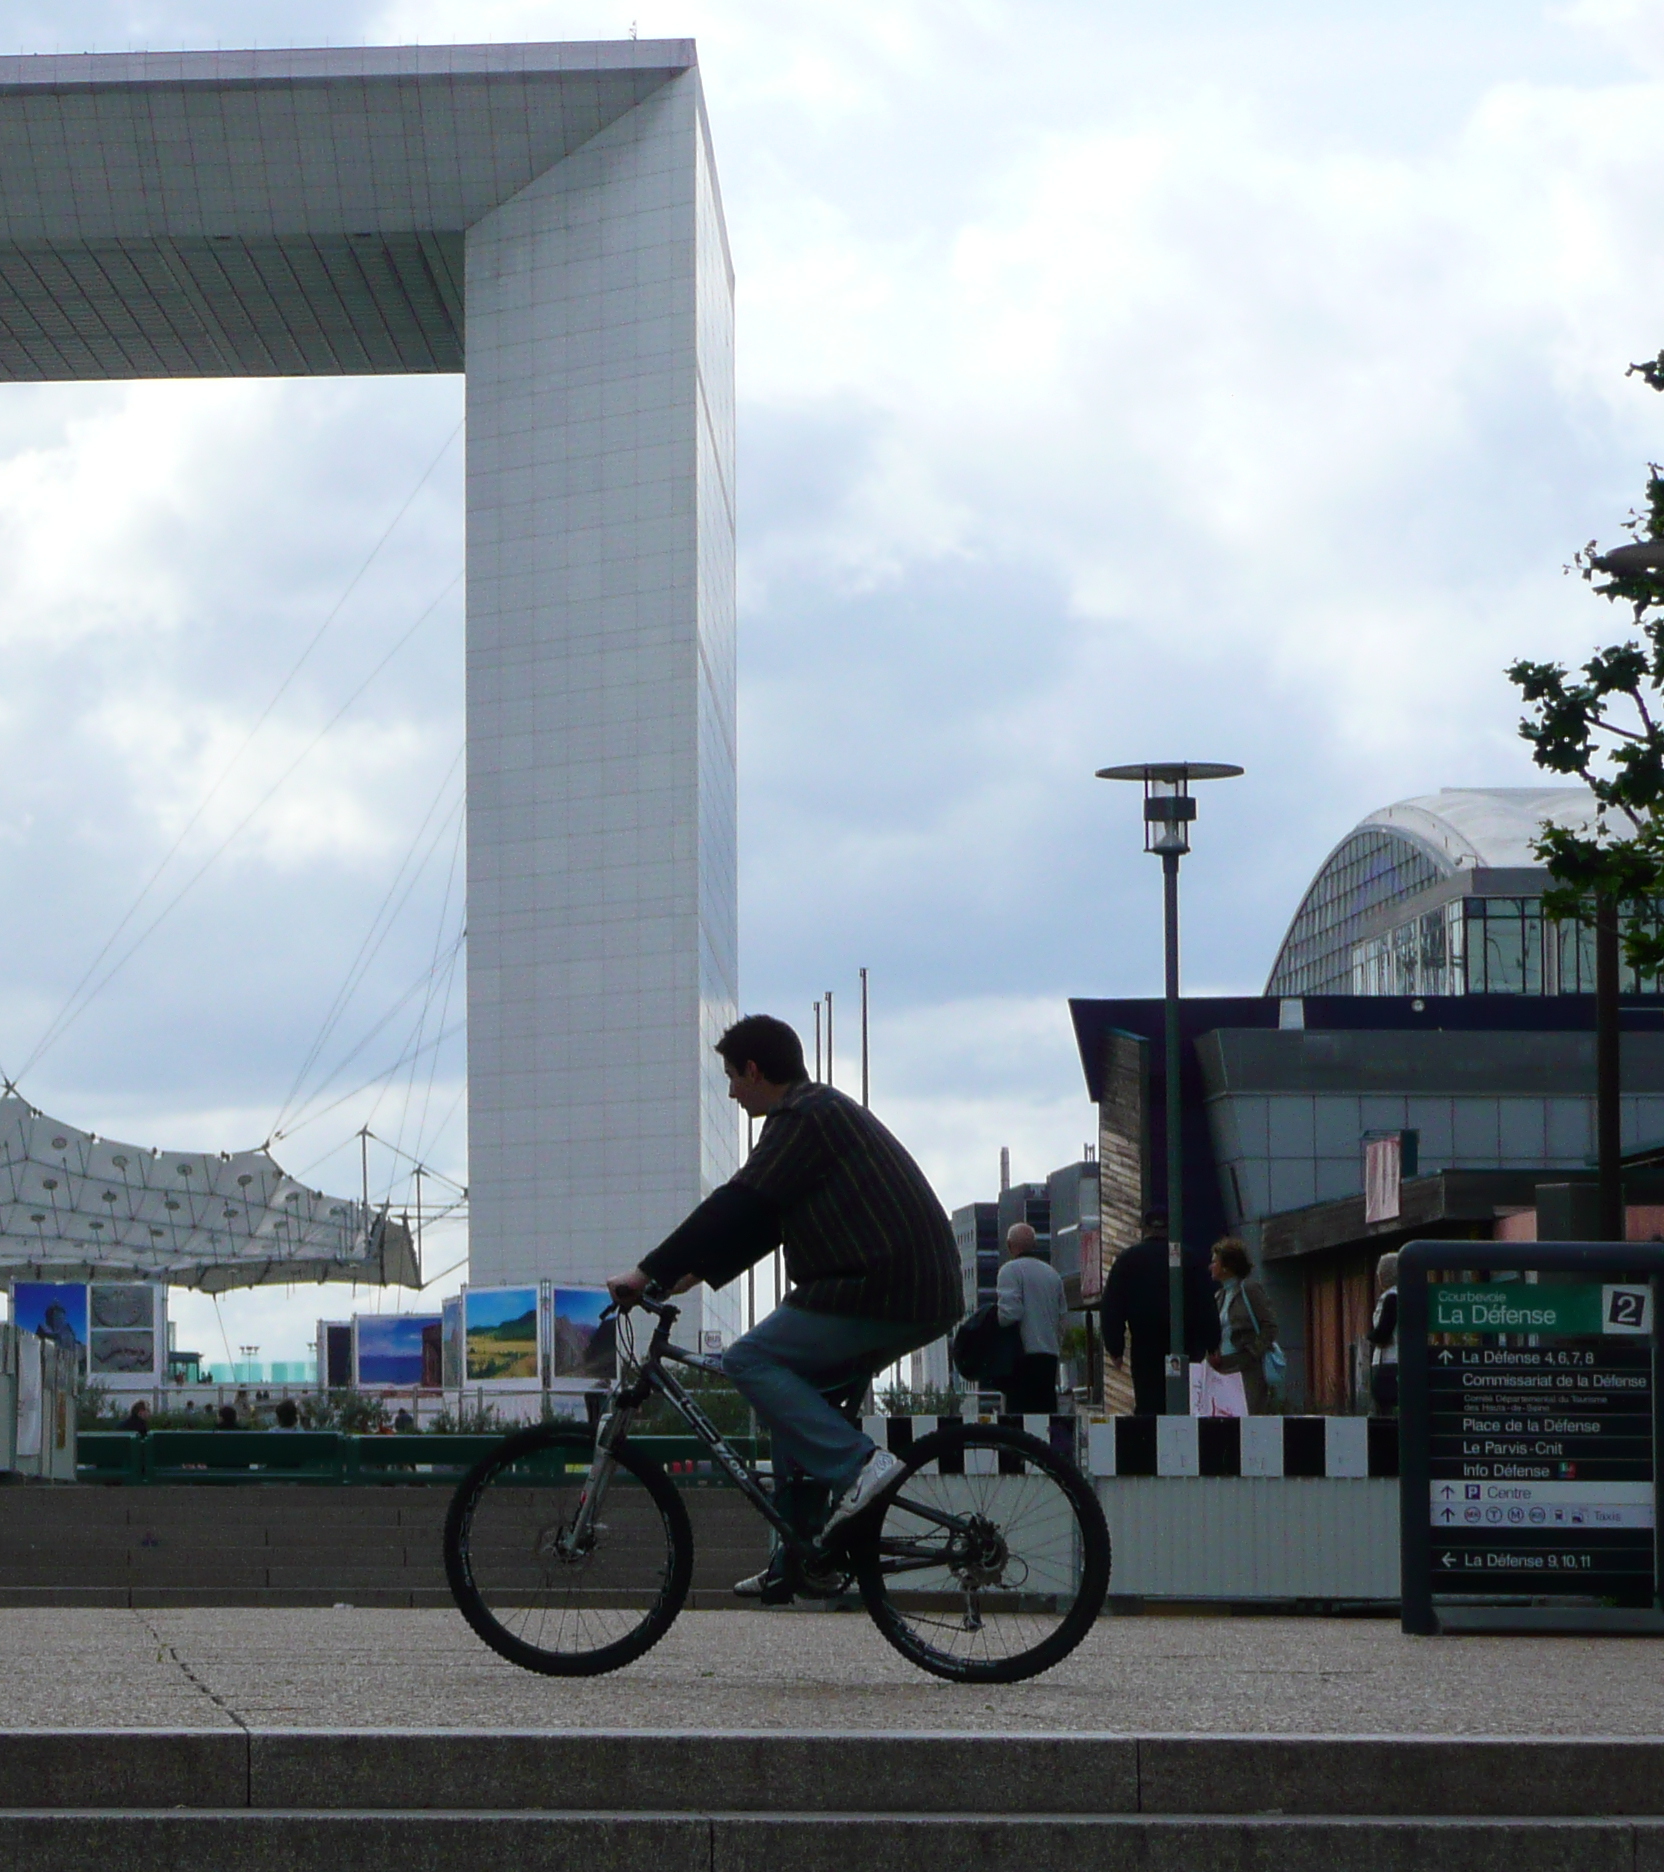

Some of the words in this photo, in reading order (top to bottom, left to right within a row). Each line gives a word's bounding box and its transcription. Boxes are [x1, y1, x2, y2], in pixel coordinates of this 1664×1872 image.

[1438, 1290, 1507, 1303] Courbevoie
[1437, 1305, 1464, 1325] La
[1472, 1303, 1557, 1325] Défense
[1617, 1295, 1636, 1322] 2
[1462, 1350, 1479, 1364] La
[1484, 1349, 1540, 1365] Défense
[1462, 1373, 1553, 1387] Commissariat
[1556, 1373, 1573, 1388] de
[1577, 1374, 1589, 1388] la
[1593, 1373, 1648, 1388] Défense
[1463, 1417, 1500, 1432] Place
[1505, 1418, 1523, 1432] de
[1527, 1418, 1539, 1432] la
[1544, 1417, 1601, 1433] Défense
[1463, 1441, 1480, 1455] Le
[1463, 1463, 1489, 1477] Info
[1493, 1463, 1550, 1478] Défense
[1487, 1486, 1532, 1500] Centre
[1593, 1510, 1622, 1522] Taxis
[1464, 1552, 1482, 1567] La
[1487, 1552, 1544, 1567] Défense
